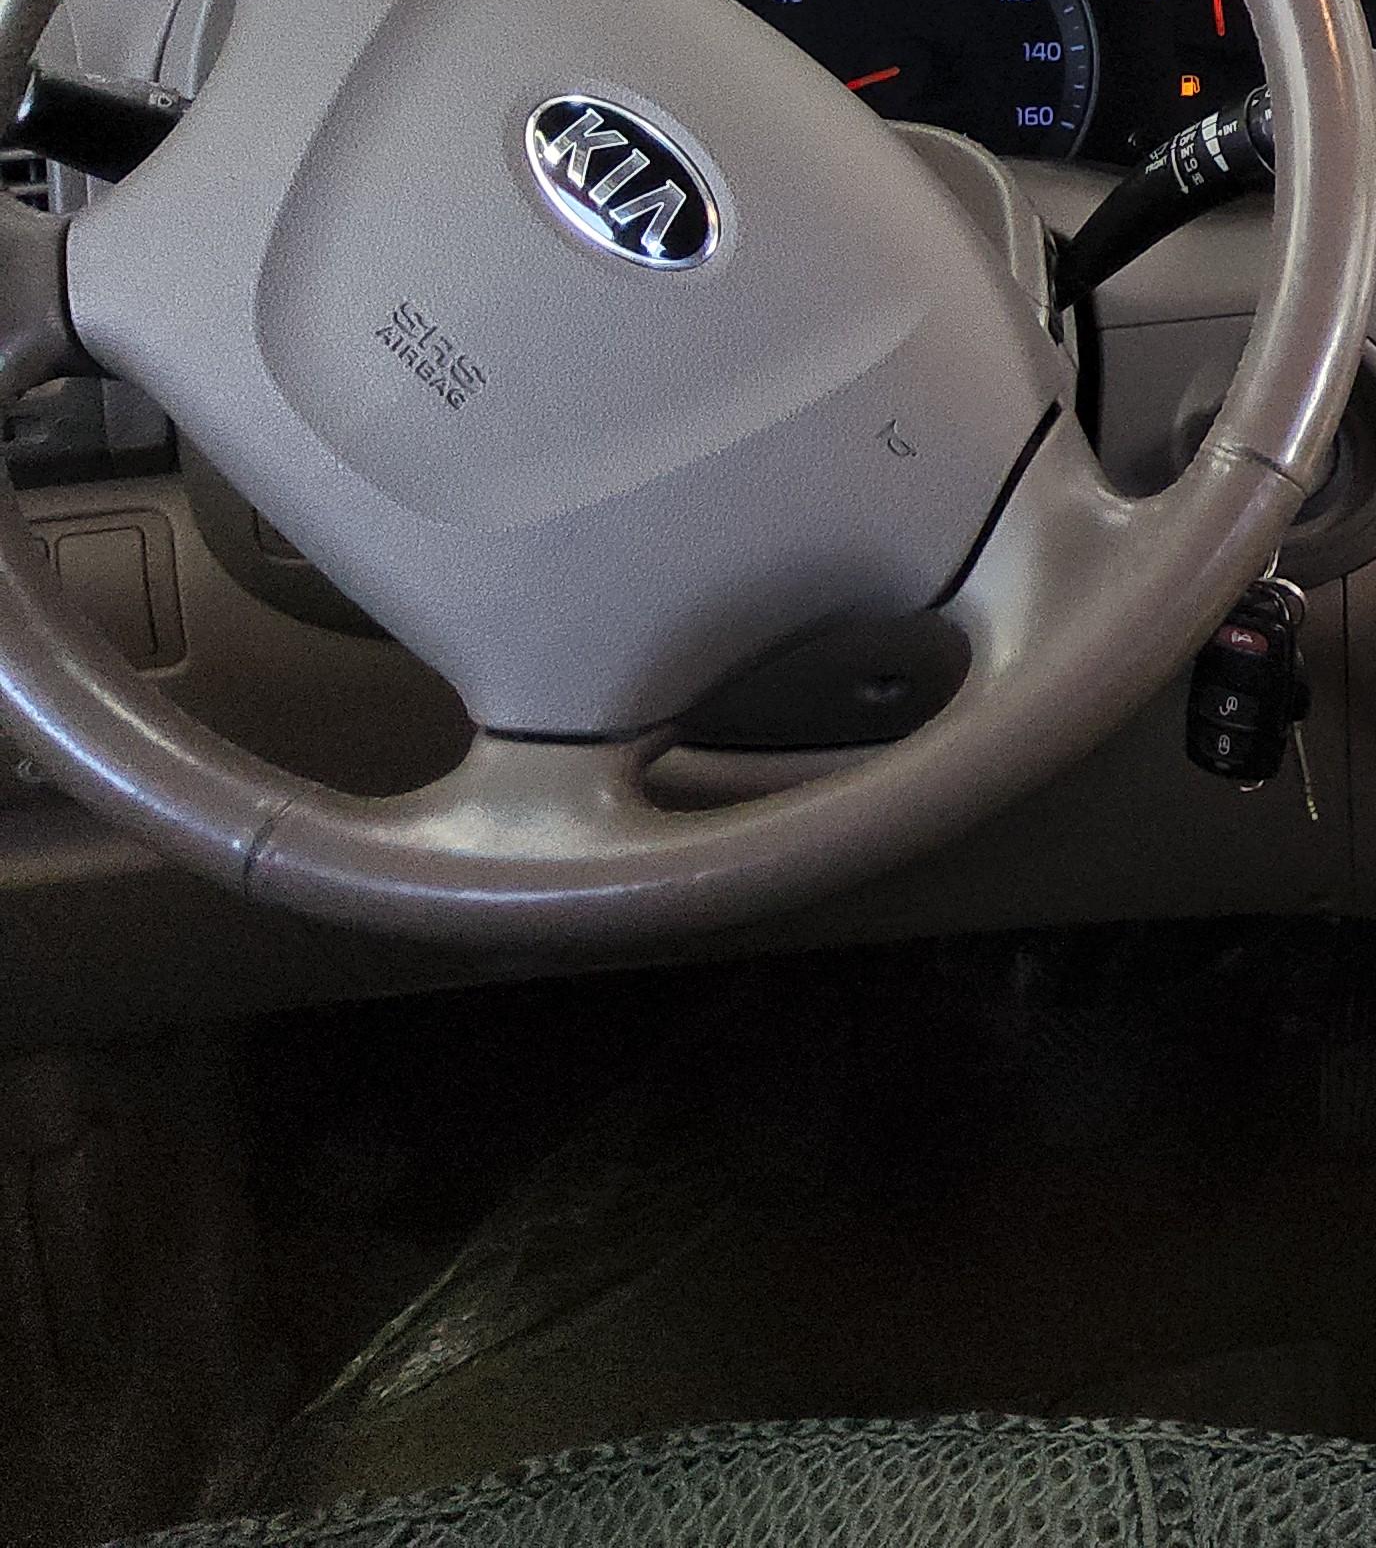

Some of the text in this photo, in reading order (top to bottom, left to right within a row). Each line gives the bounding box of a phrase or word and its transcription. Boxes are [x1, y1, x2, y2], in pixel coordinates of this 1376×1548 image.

[1023, 42, 1061, 62] 140
[1015, 106, 1054, 127] 160
[1222, 120, 1238, 136] INT
[1180, 143, 1195, 159] INT
[1184, 158, 1198, 172] LO
[542, 107, 687, 258] KIA
[1192, 173, 1205, 185] HI
[375, 325, 467, 412] AIRBAG
